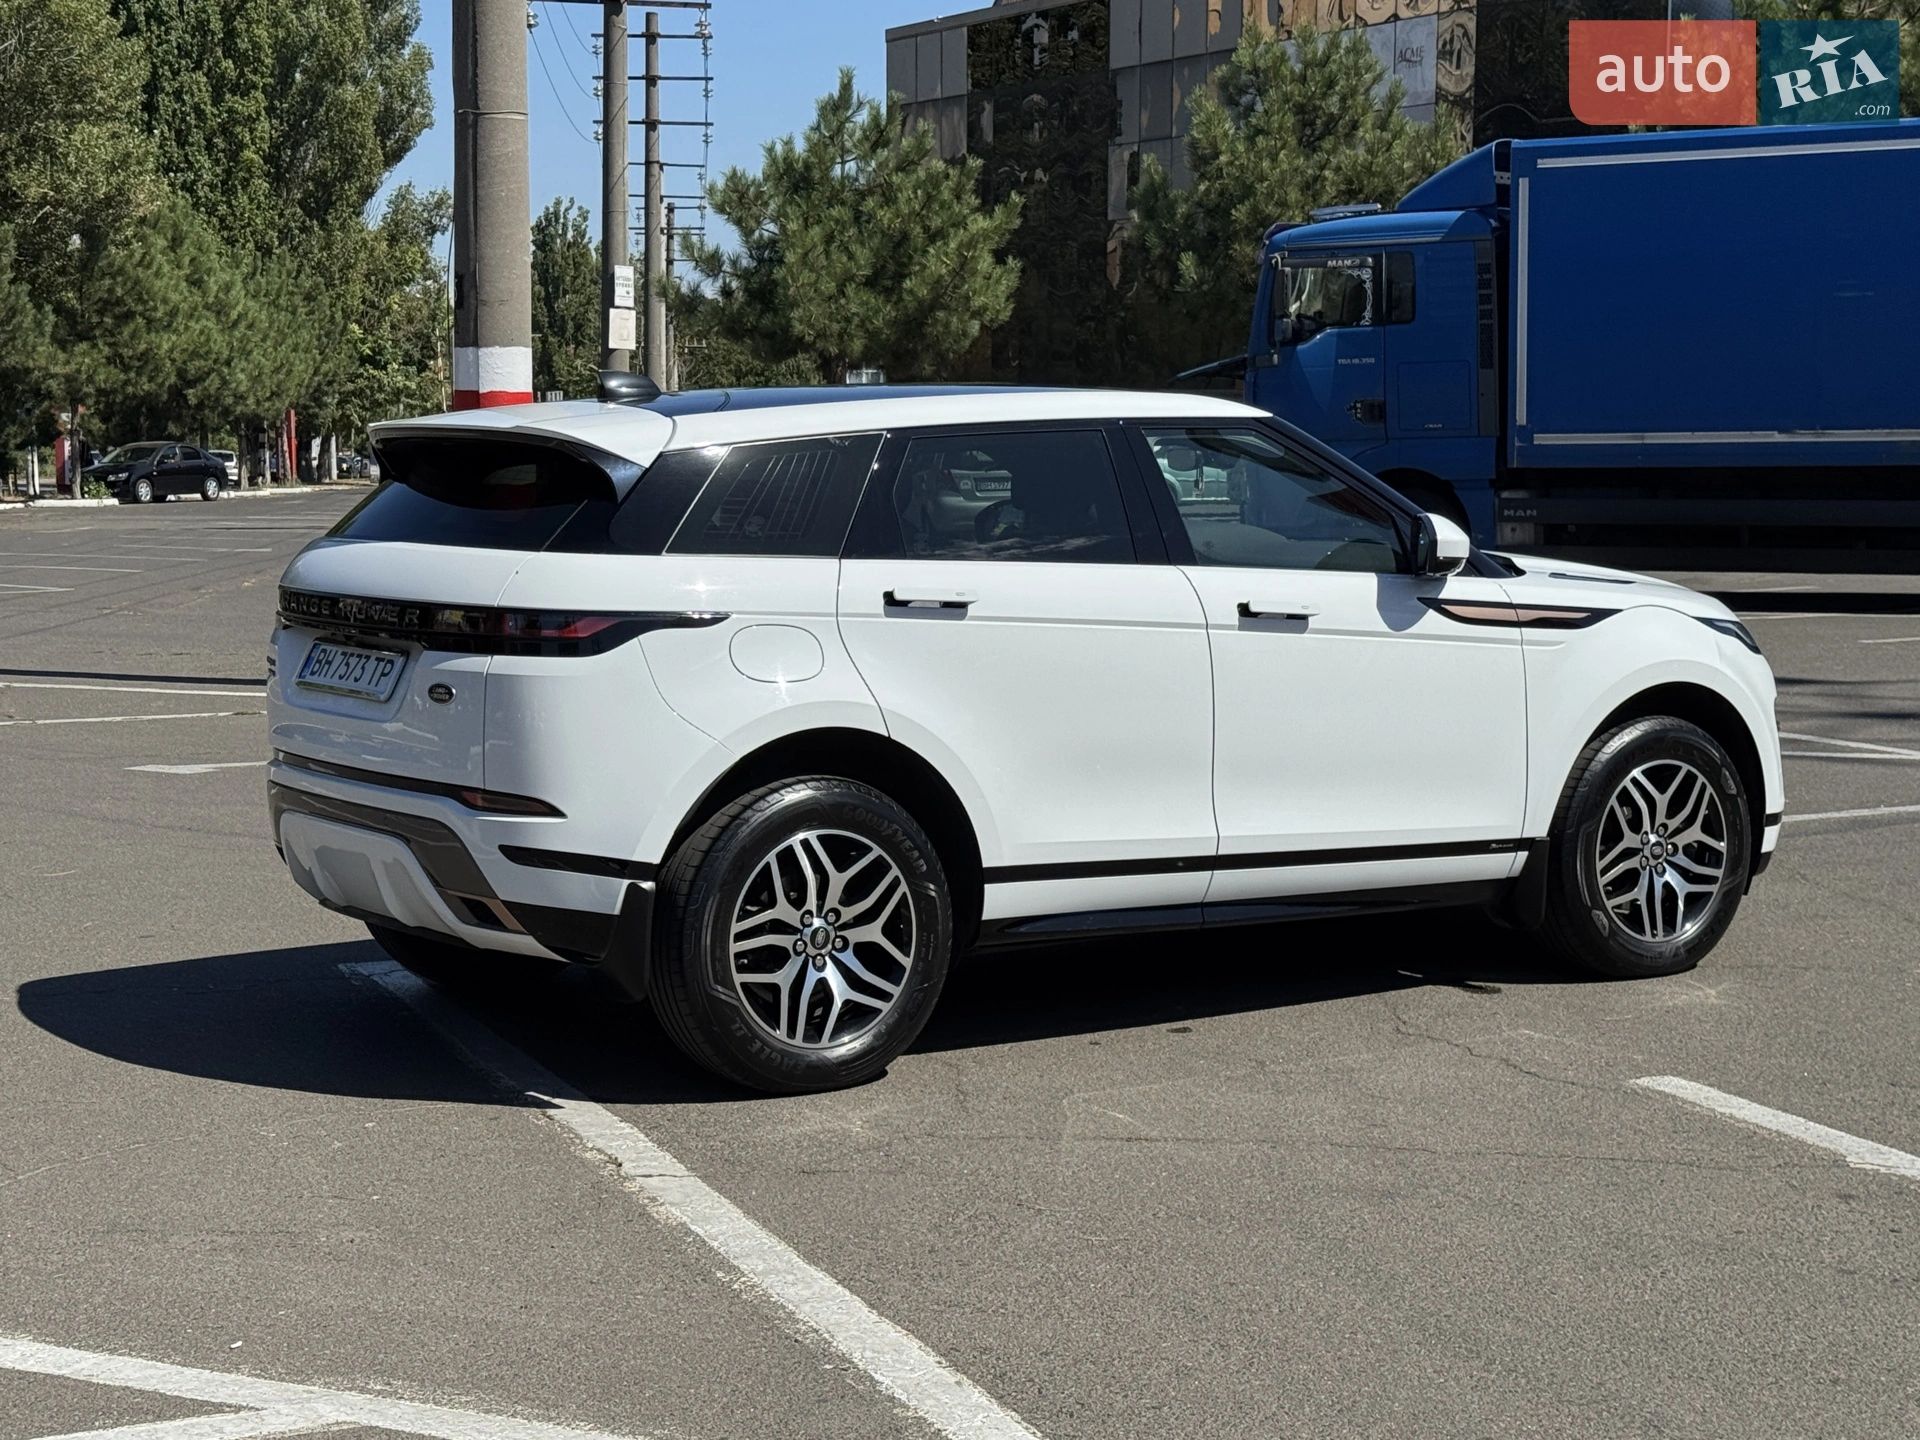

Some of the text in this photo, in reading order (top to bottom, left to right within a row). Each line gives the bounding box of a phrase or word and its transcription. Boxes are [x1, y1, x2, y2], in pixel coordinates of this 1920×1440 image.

[1327, 260, 1351, 268] MAN
[1503, 509, 1537, 517] MAN
[281, 590, 420, 624] RANGE ROVER
[309, 648, 395, 687] BH 7573 TP
